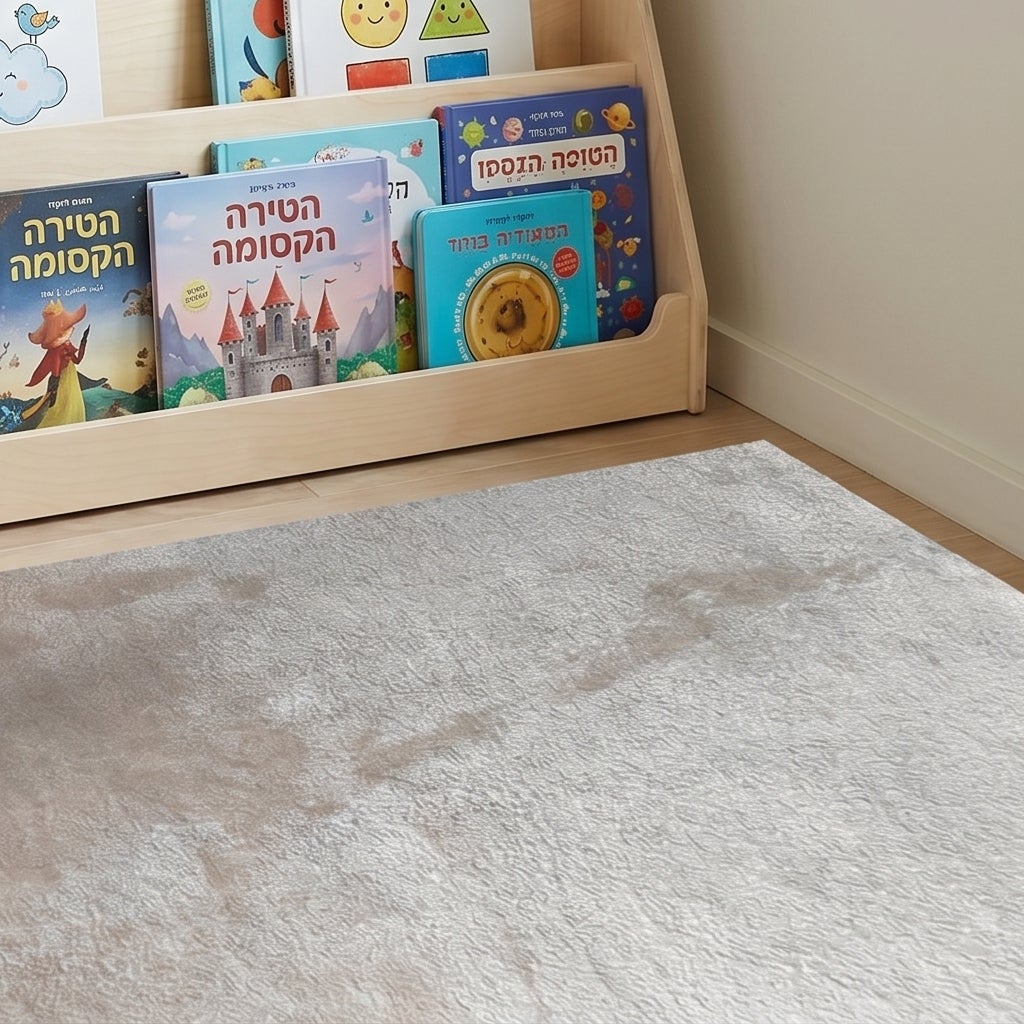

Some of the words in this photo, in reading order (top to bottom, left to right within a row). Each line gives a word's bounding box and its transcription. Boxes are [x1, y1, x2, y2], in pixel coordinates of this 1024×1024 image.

[23, 209, 120, 246] הטירה
[226, 194, 321, 230] הטירה
[9, 241, 135, 282] הקסומה
[212, 226, 336, 266] הקסומה
